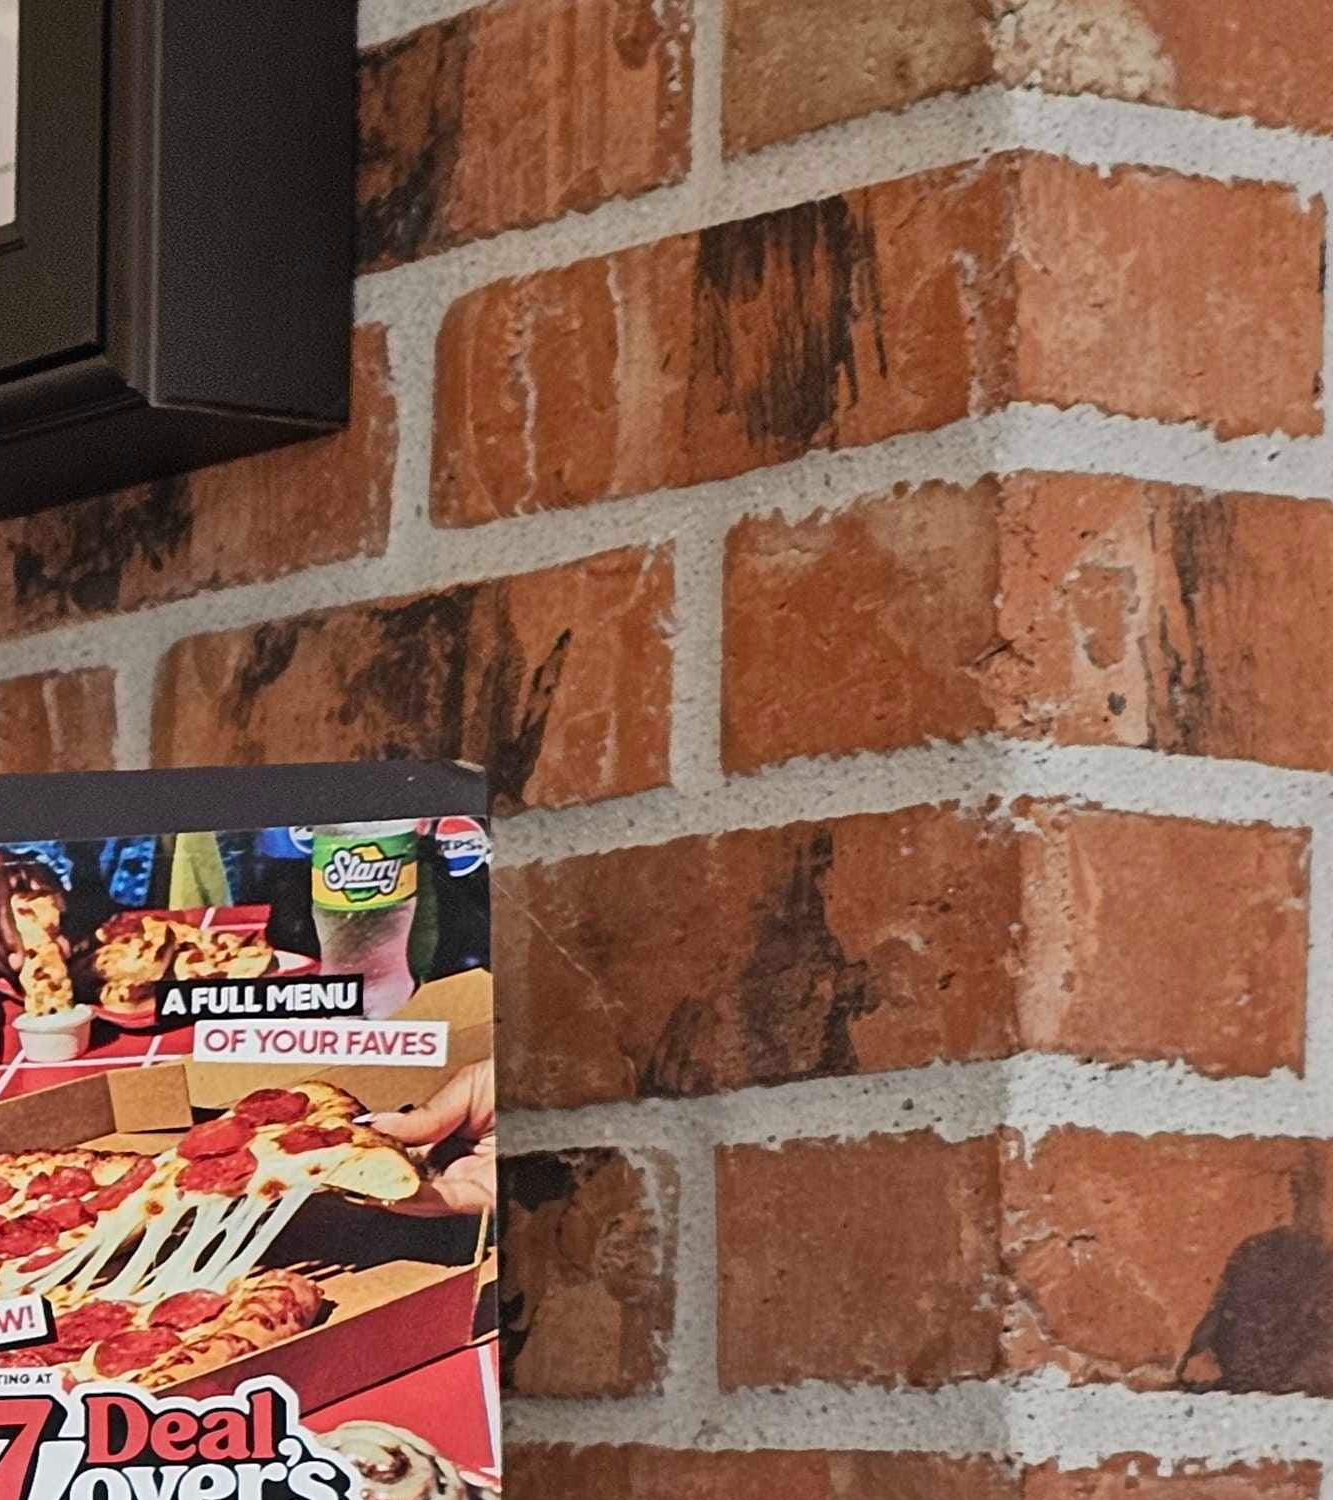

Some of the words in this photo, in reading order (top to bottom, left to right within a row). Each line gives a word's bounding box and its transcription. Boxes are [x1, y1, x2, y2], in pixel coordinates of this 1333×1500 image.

[323, 848, 402, 893] Starry
[160, 986, 186, 1016] A
[190, 984, 264, 1015] FULL
[266, 981, 359, 1013] MENU
[204, 1028, 248, 1053] OF
[253, 1029, 339, 1056] YOUR
[344, 1030, 438, 1057] FAVES
[35, 1371, 55, 1386] AT
[83, 1389, 275, 1464] Deal
